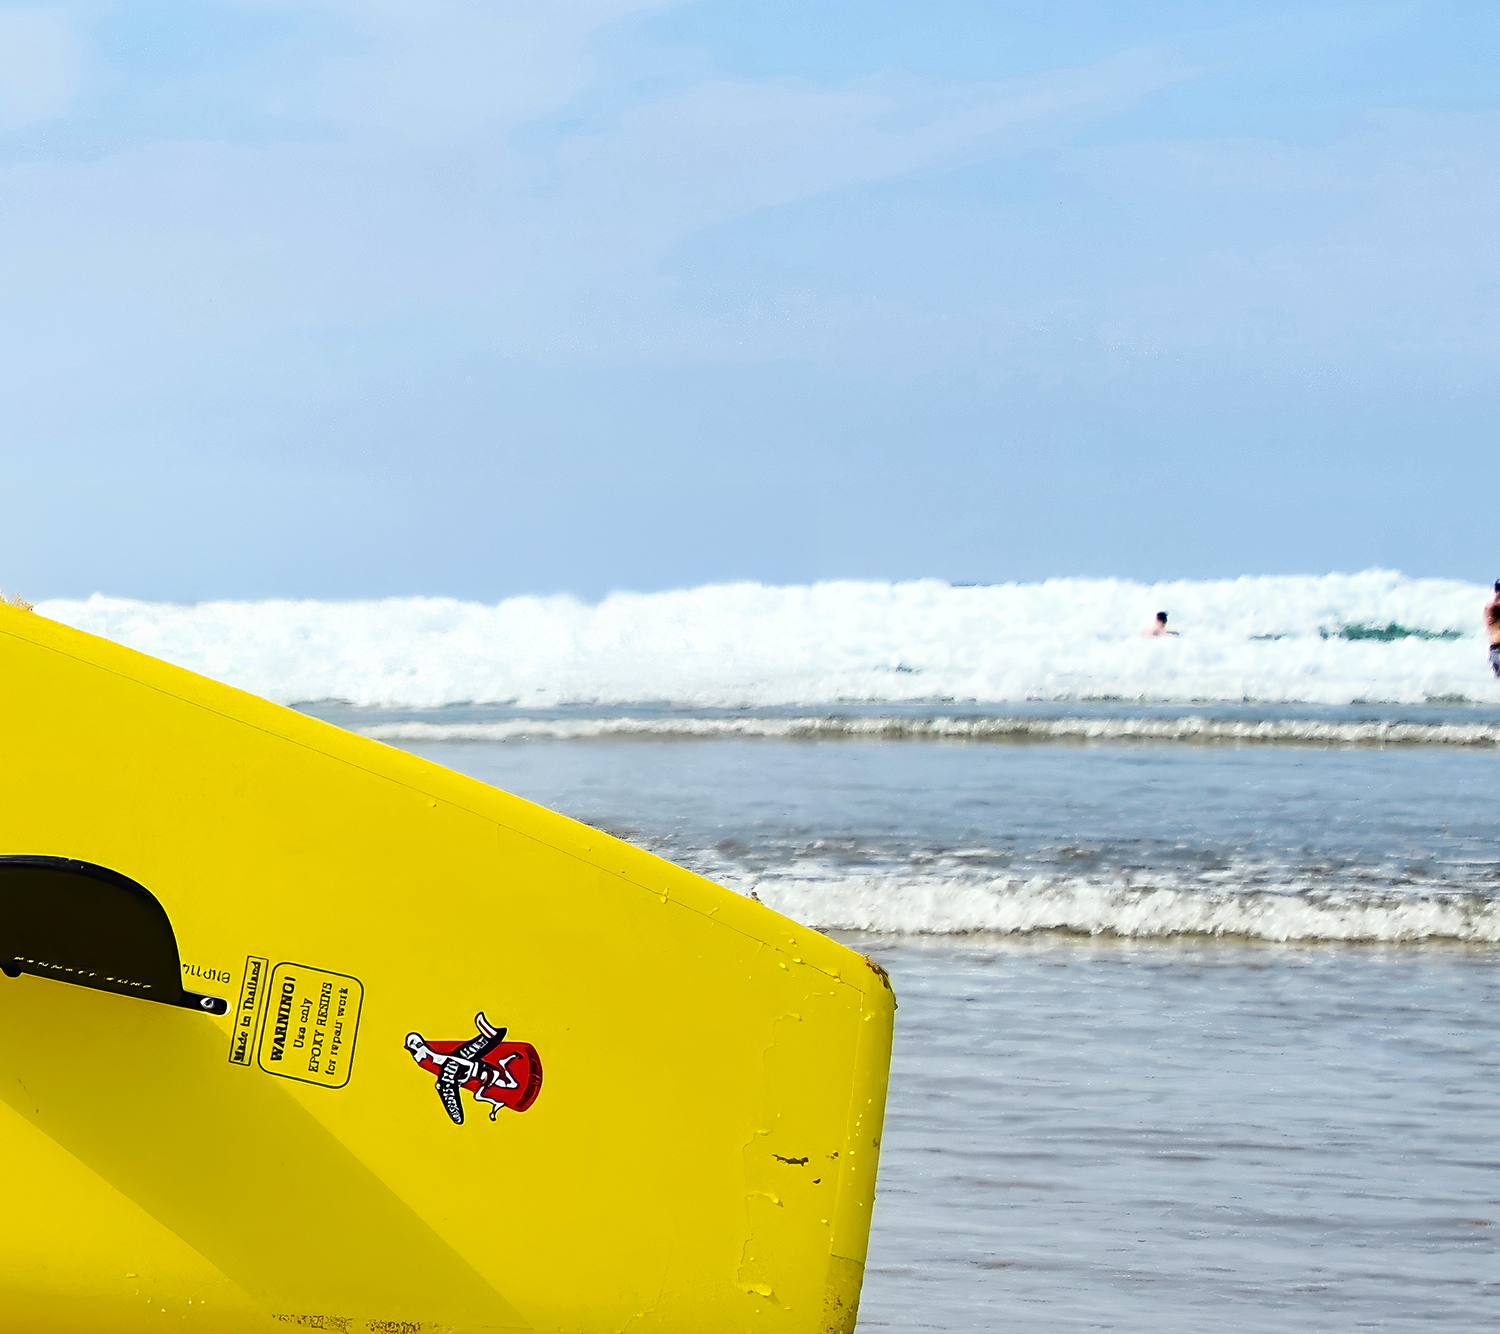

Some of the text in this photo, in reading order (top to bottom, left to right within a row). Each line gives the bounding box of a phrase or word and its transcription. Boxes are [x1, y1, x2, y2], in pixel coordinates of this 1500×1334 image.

[234, 961, 262, 1063] Made in Thailand
[270, 976, 297, 1062] WARNING!
[293, 997, 314, 1049] Use only
[308, 982, 333, 1074] EPOXY RESINS
[325, 987, 349, 1076] for repair work
